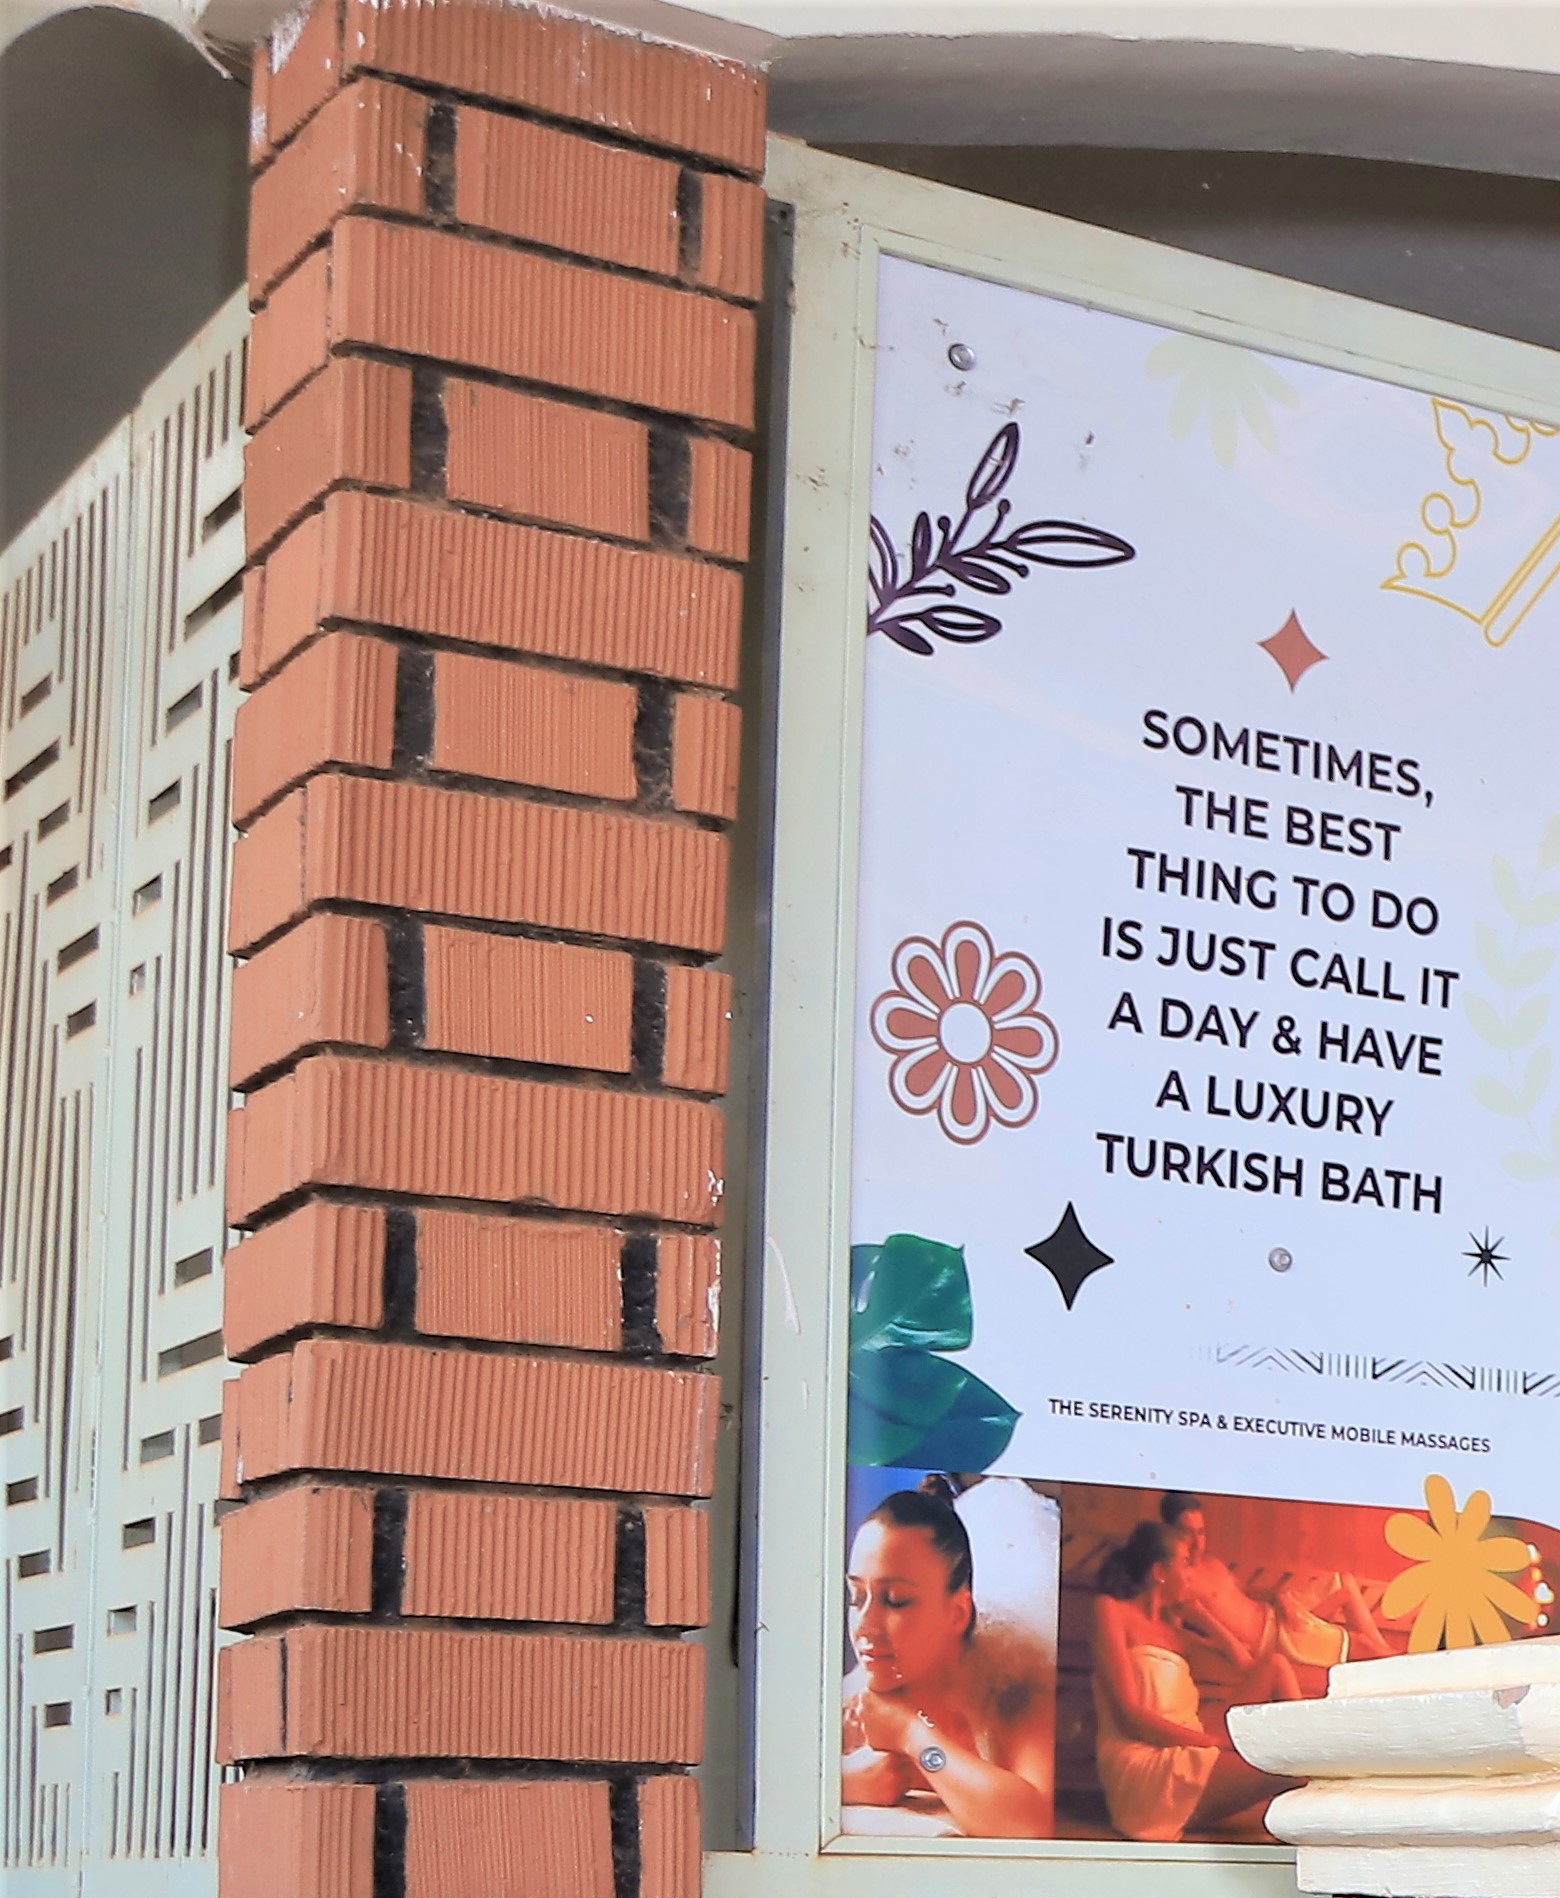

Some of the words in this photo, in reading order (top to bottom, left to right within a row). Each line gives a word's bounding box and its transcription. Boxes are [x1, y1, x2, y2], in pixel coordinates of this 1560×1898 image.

[1143, 710, 1434, 808] SOMETIMES,
[1176, 785, 1269, 839] THE
[1286, 805, 1401, 861] BEST
[1127, 848, 1277, 909] THING
[1293, 876, 1355, 922] TO
[1371, 890, 1439, 935] DO
[1102, 916, 1143, 961] IS
[1157, 926, 1276, 980] JUST
[1290, 948, 1405, 1001] CALL
[1421, 967, 1459, 1008] IT
[1108, 991, 1143, 1034] A
[1160, 998, 1260, 1048] DAY
[1271, 1015, 1302, 1055] &
[1319, 1021, 1443, 1076] HAVE
[1156, 1069, 1191, 1112] A
[1207, 1075, 1394, 1136] LUXURY
[1096, 1132, 1304, 1197] TURKISH
[1321, 1161, 1442, 1214] BATH
[1048, 1398, 1084, 1416] THE
[1089, 1402, 1174, 1425] SERENITY
[1178, 1411, 1212, 1428] SPA
[1217, 1414, 1228, 1429] &
[1234, 1416, 1326, 1438] EXECUTIVE
[1331, 1425, 1396, 1445] MOBILE
[1401, 1431, 1491, 1453] MASSAGES
